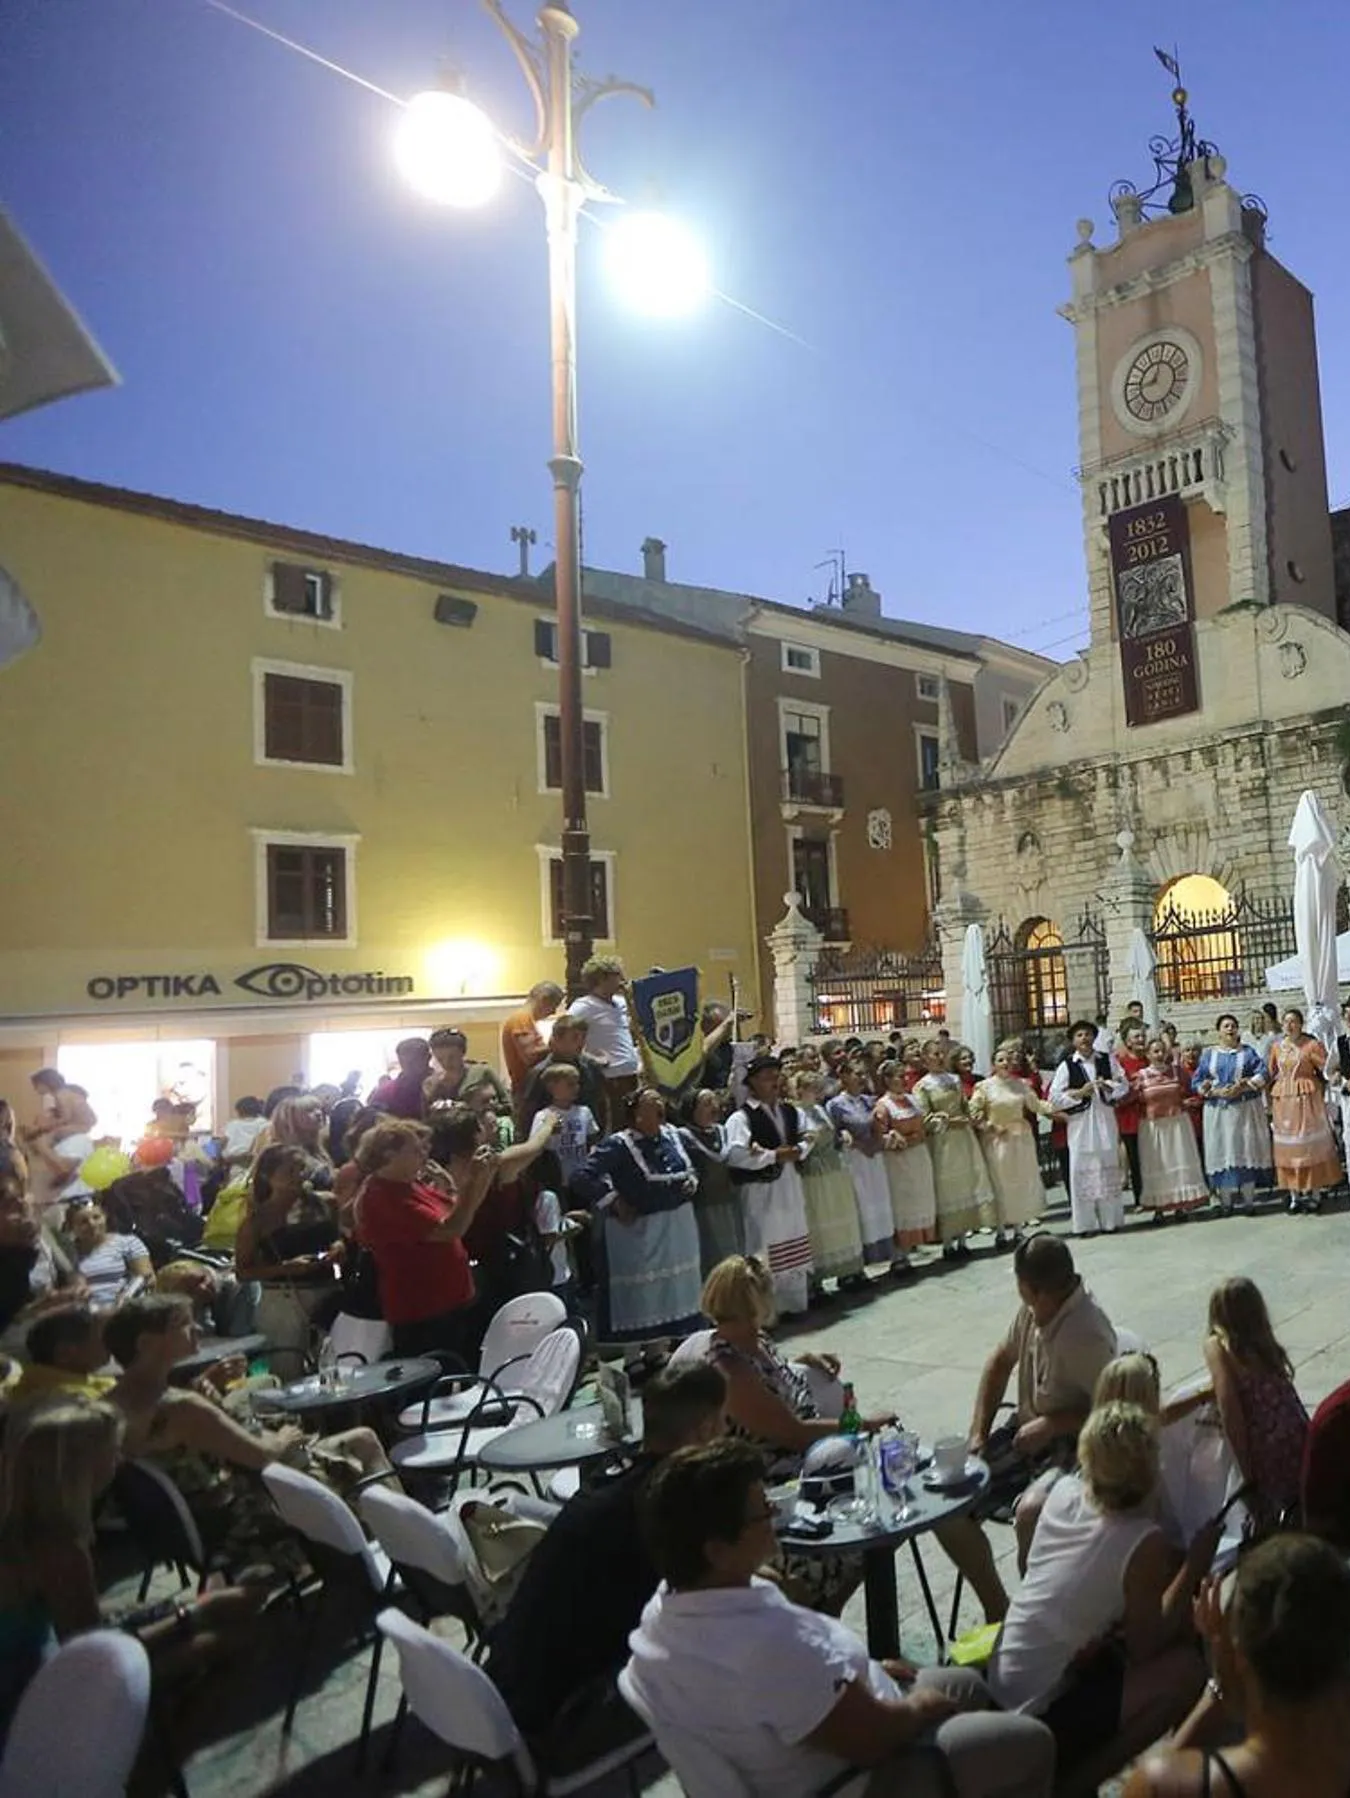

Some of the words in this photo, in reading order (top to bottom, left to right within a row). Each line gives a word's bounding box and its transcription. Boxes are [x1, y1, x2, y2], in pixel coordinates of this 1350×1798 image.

[1127, 511, 1166, 537] 1832
[1127, 536, 1169, 562] 2012
[1146, 639, 1177, 661] 180
[1133, 653, 1188, 678] GODINA
[86, 973, 222, 1000] OPTIKA
[267, 966, 414, 1000] Optotim
